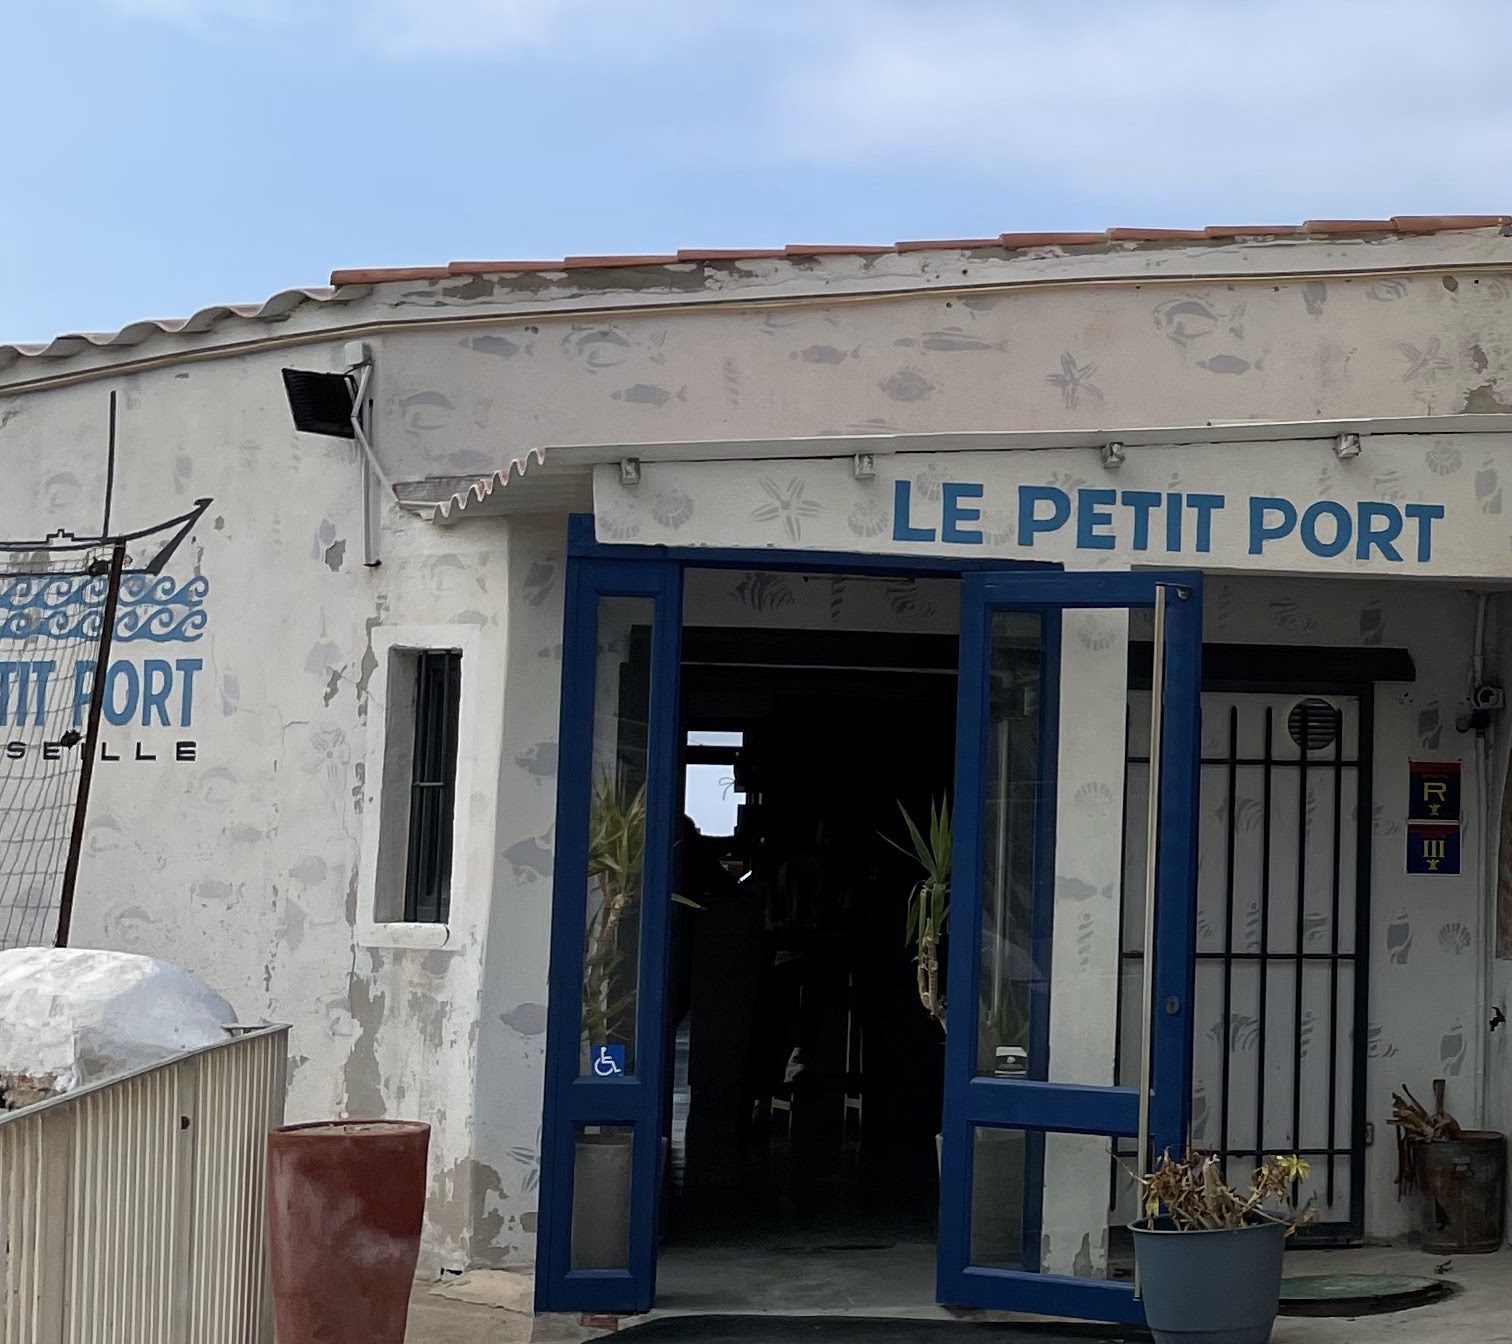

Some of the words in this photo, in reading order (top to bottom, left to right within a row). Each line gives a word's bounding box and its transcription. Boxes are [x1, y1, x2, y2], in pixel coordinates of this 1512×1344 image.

[892, 479, 984, 545] LE
[1017, 484, 1225, 554] PETIT
[1248, 496, 1445, 562] PORT
[72, 658, 203, 727] PORT
[1423, 782, 1447, 802] R
[1422, 840, 1446, 858] III
